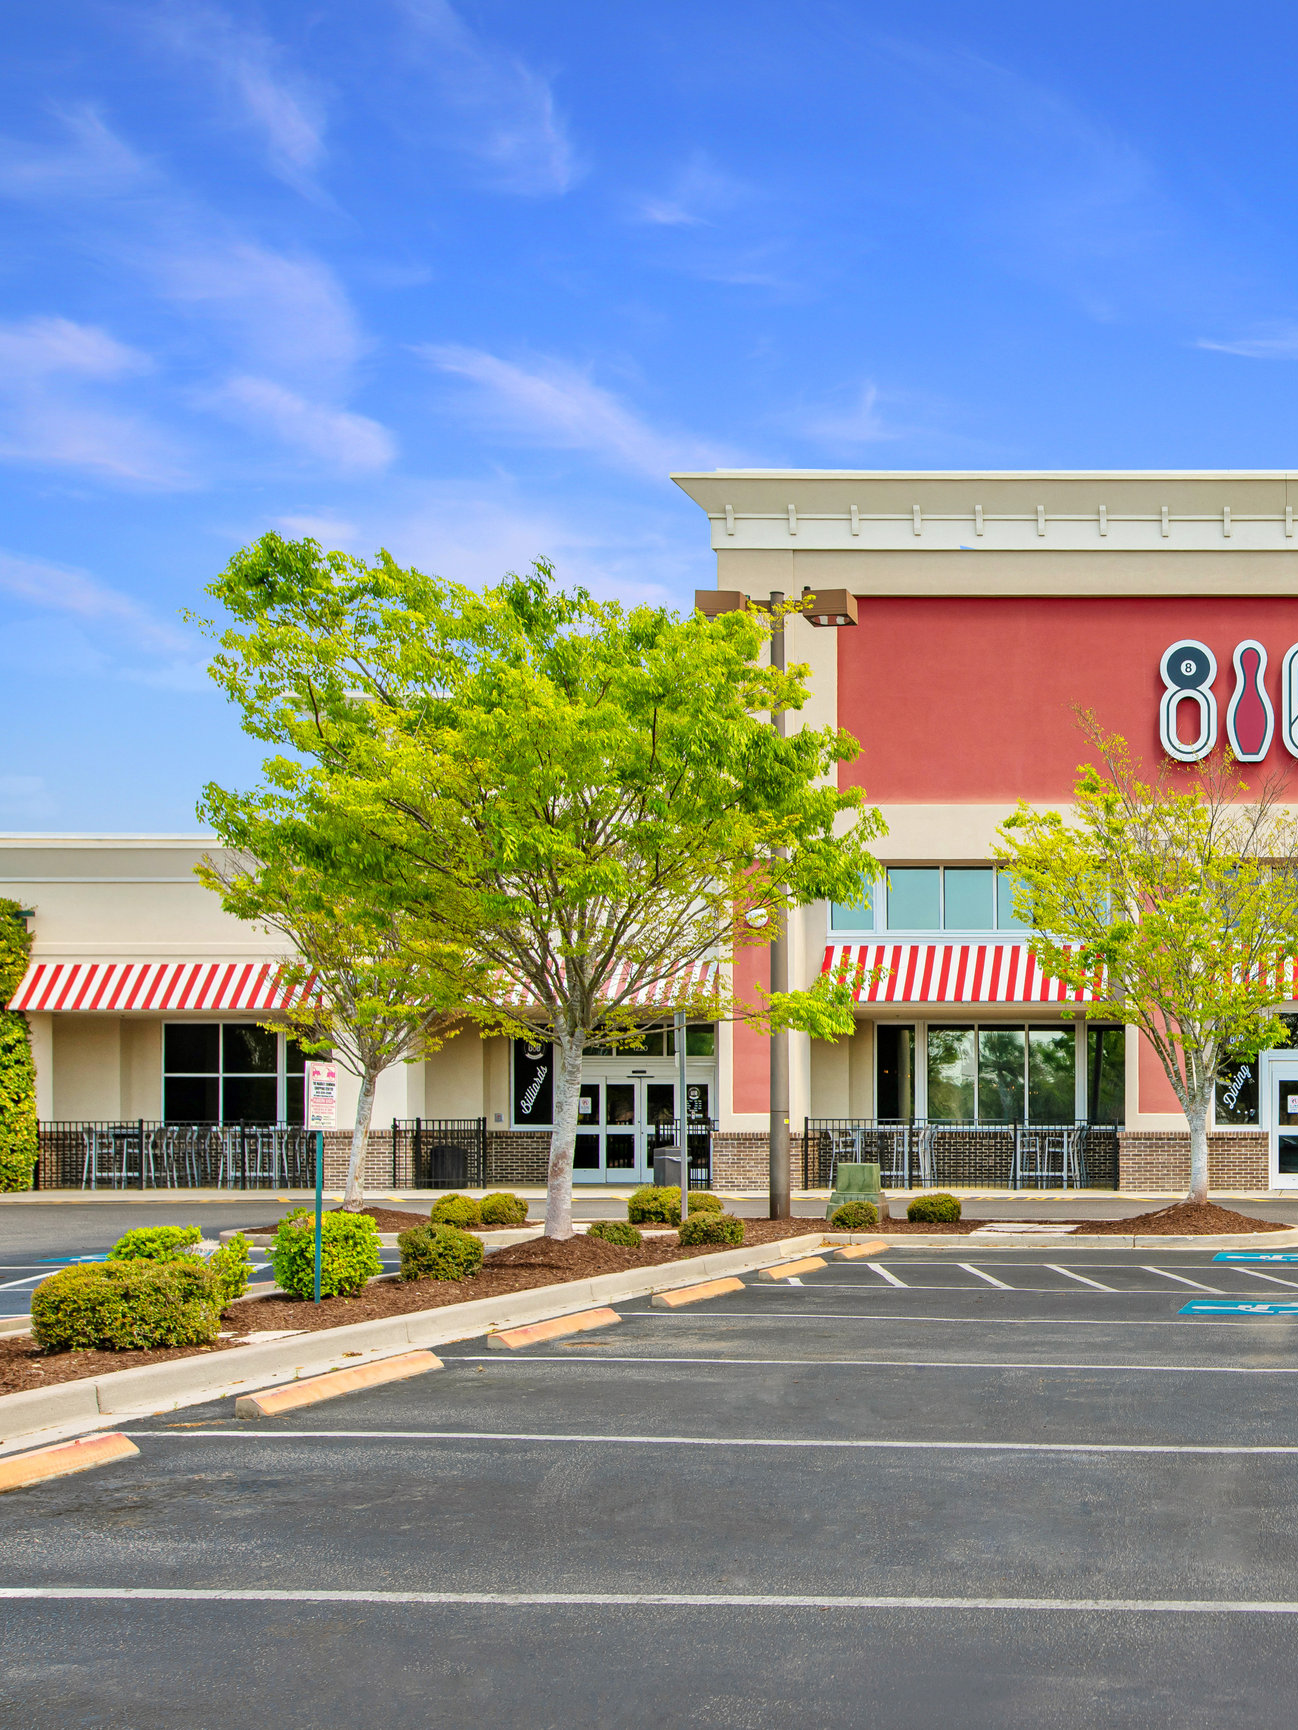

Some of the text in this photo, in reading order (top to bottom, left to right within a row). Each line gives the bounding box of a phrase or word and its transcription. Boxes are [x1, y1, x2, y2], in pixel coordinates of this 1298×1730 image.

[1185, 663, 1192, 673] 8
[520, 1065, 548, 1115] Billiards
[1223, 1064, 1252, 1110] Dining
